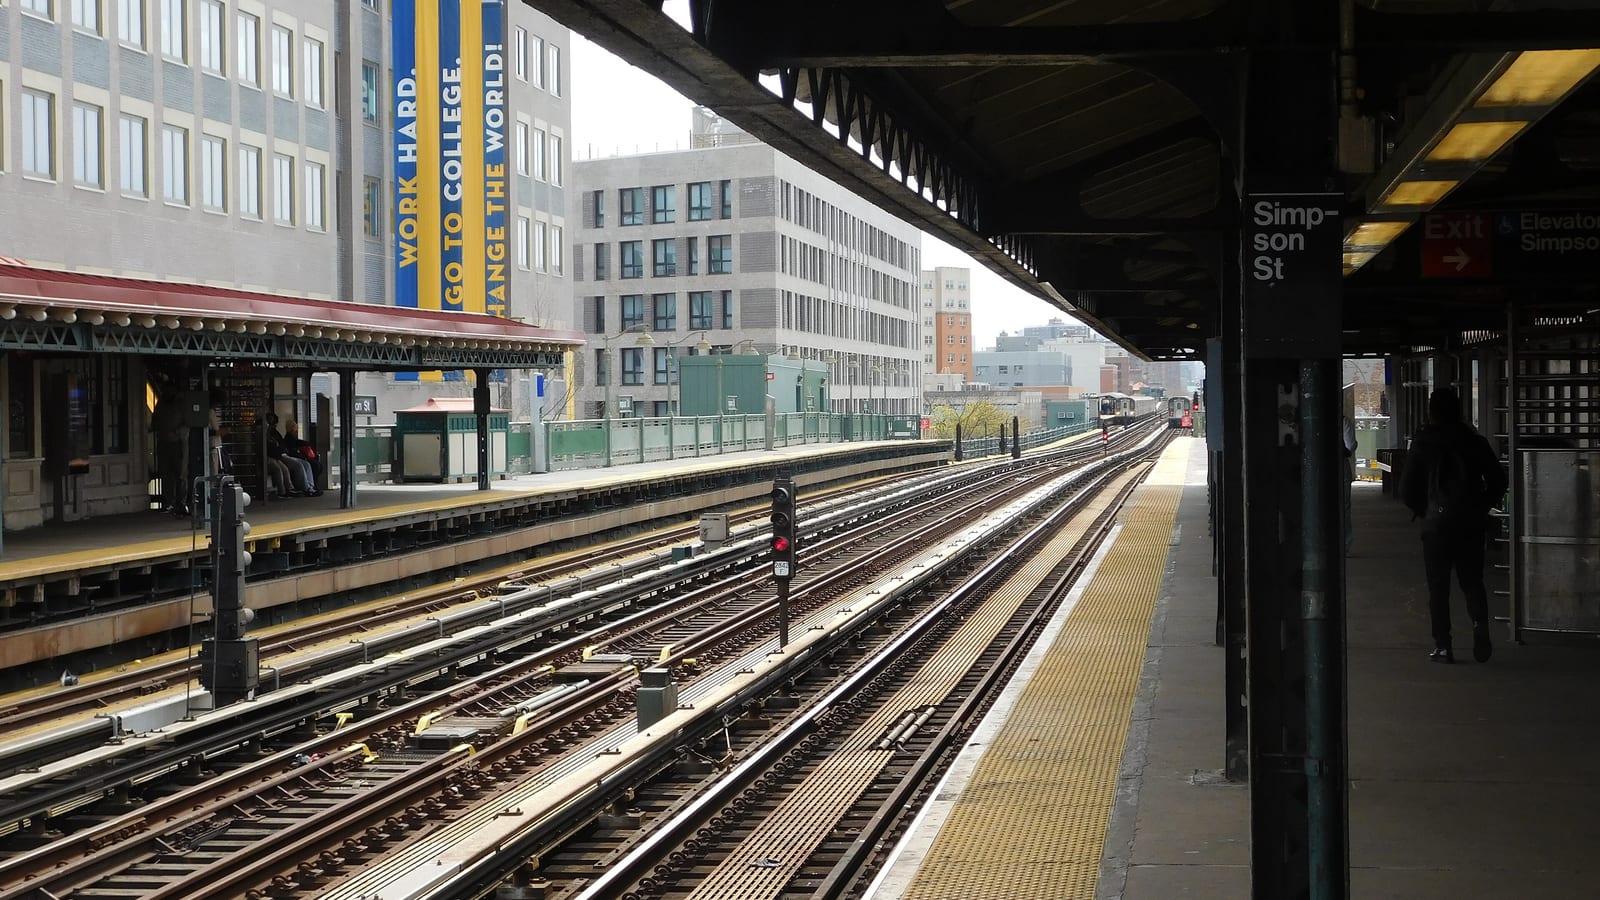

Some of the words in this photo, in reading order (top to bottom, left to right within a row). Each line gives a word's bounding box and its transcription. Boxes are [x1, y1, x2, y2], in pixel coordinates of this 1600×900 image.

[397, 68, 417, 163] HARD.
[485, 43, 503, 153] WORLD!
[442, 57, 462, 202] COLLEGE.
[486, 162, 505, 216] THE
[399, 175, 418, 269] WORK
[444, 211, 463, 251] TO
[1253, 201, 1339, 230] Simp-
[1424, 213, 1484, 240] Exit
[1253, 232, 1305, 251] son
[1520, 233, 1600, 255] Simpso
[445, 261, 463, 305] GO
[486, 226, 505, 318] HANGE
[1253, 255, 1285, 281] St
[354, 402, 362, 411] on
[363, 400, 370, 412] St
